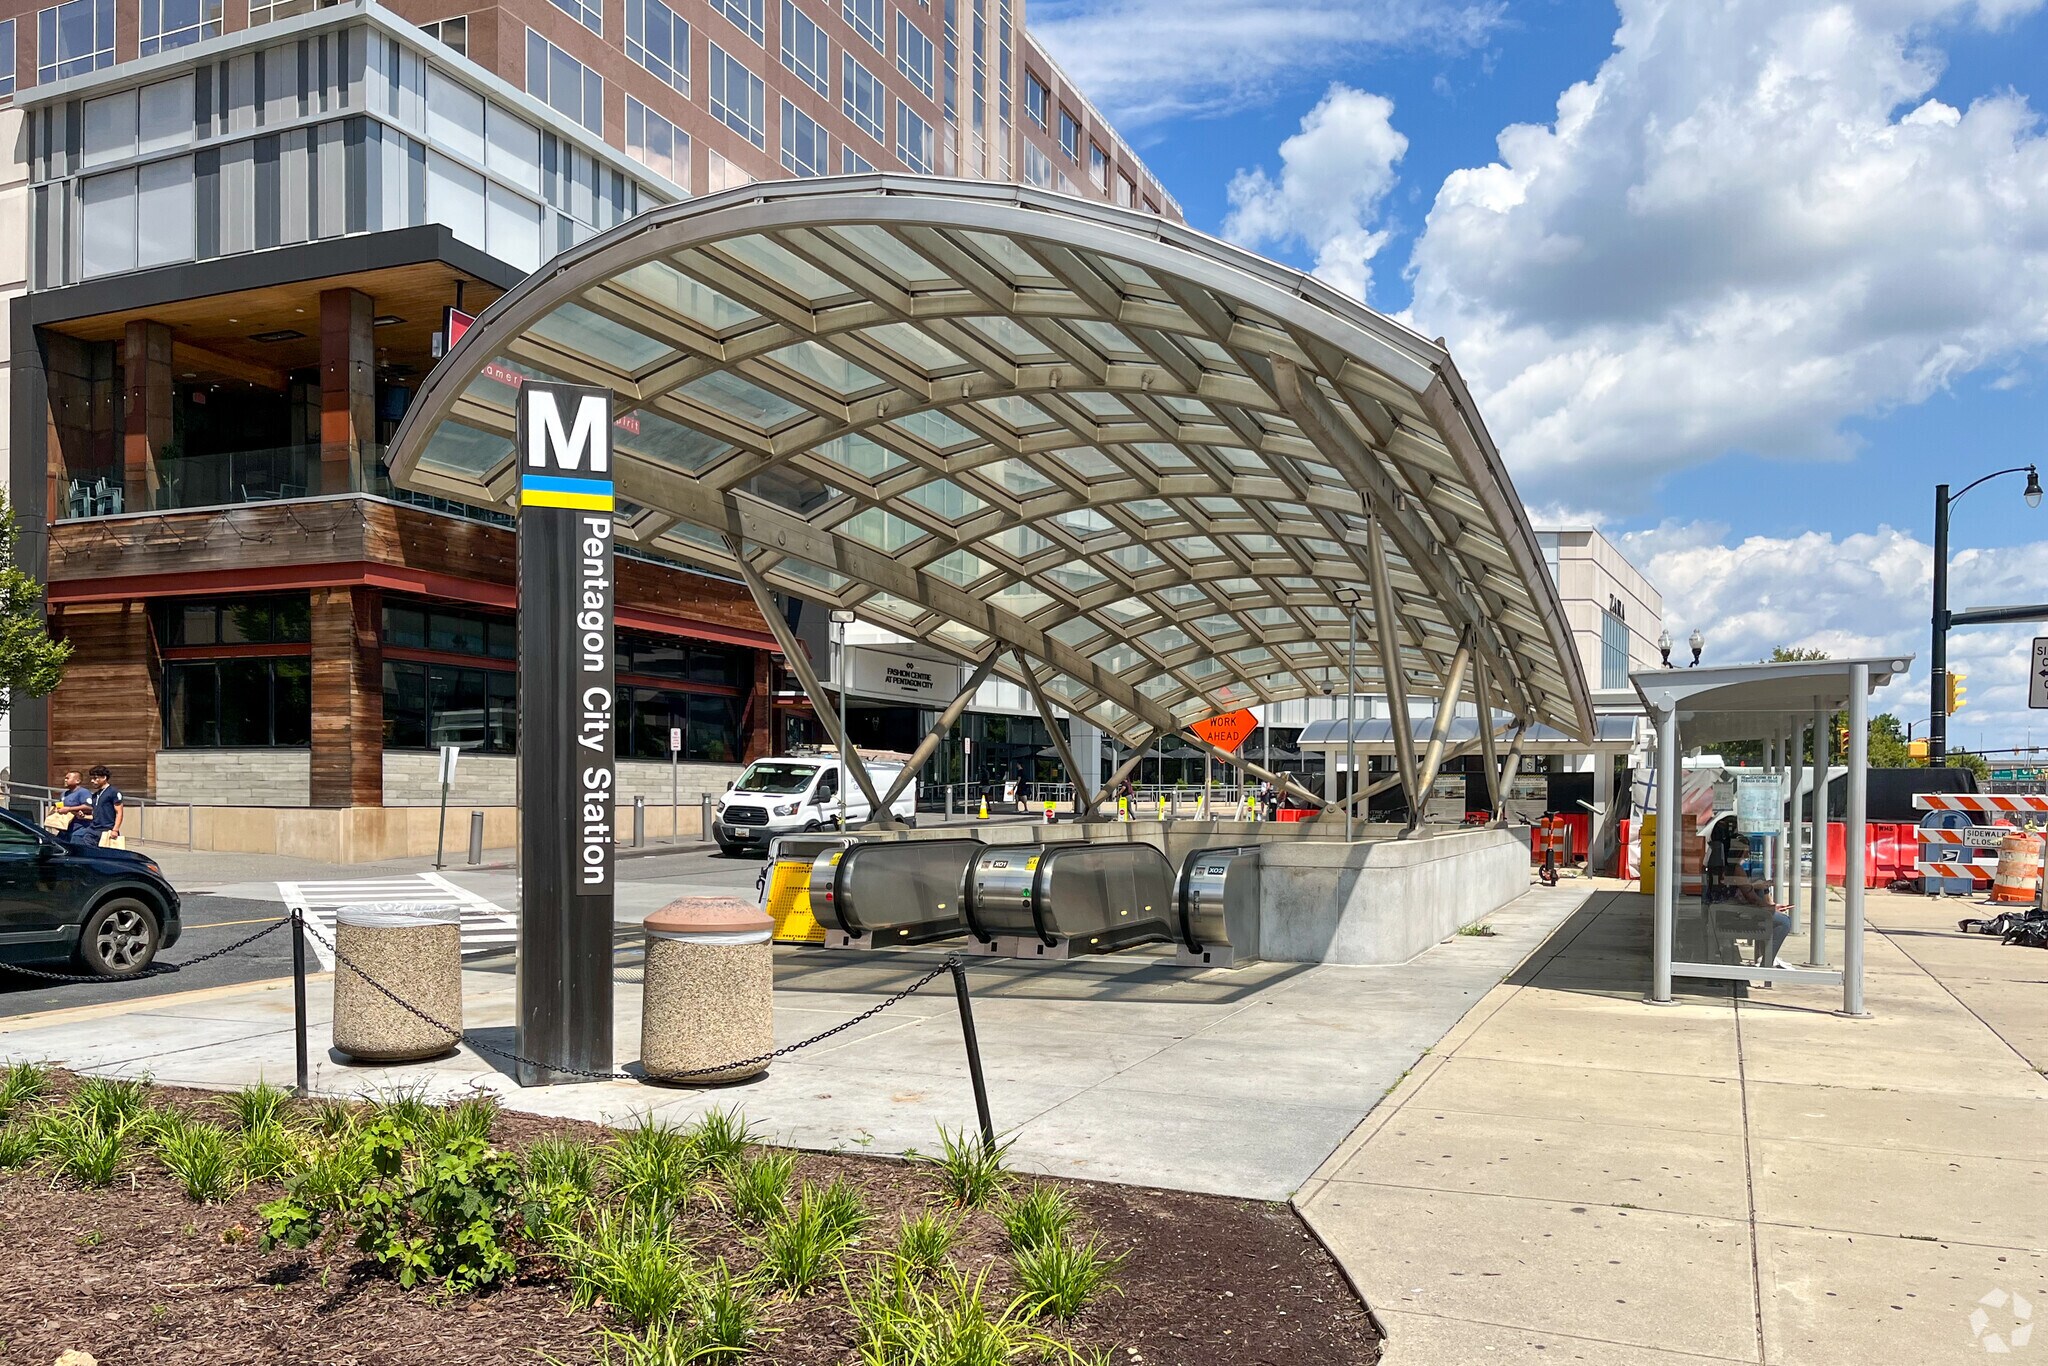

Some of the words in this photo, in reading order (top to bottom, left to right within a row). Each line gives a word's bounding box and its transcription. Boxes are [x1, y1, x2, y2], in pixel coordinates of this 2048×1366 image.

[528, 390, 607, 472] M
[577, 517, 610, 672] Pentagon
[1609, 593, 1625, 621] ZARA
[887, 668, 910, 677] FASHION
[911, 671, 932, 681] CENTRE
[893, 677, 921, 687] PENTAGON
[922, 681, 933, 689] CITY
[578, 686, 612, 752] City
[1210, 717, 1237, 727] WORK
[1207, 731, 1240, 741] AHEAD
[582, 767, 612, 884] Station
[1967, 830, 2006, 838] SIDEWALK
